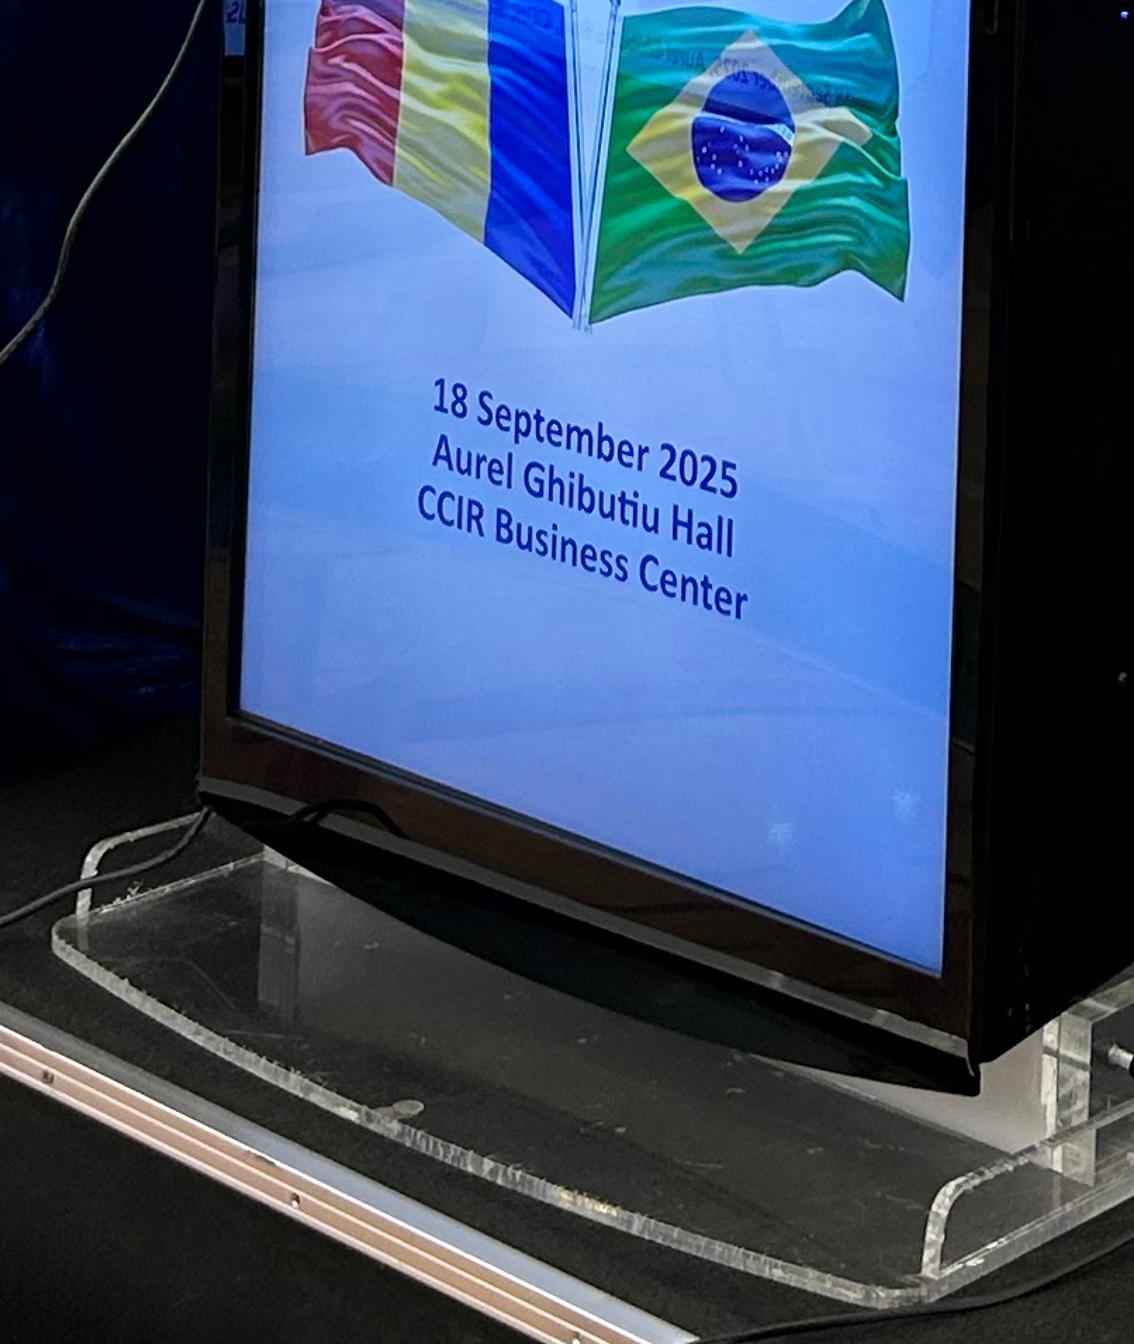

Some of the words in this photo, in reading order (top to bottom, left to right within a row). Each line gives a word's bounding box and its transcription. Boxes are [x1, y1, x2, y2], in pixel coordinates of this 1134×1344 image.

[432, 433, 514, 490] Aurel
[524, 461, 660, 535] Ghibutiu
[672, 504, 734, 558] Hall
[433, 378, 469, 419] 18
[477, 390, 651, 472] September
[659, 443, 739, 499] 2025
[418, 485, 485, 537] CCIR
[496, 508, 629, 583] Business
[640, 554, 749, 620] Center
